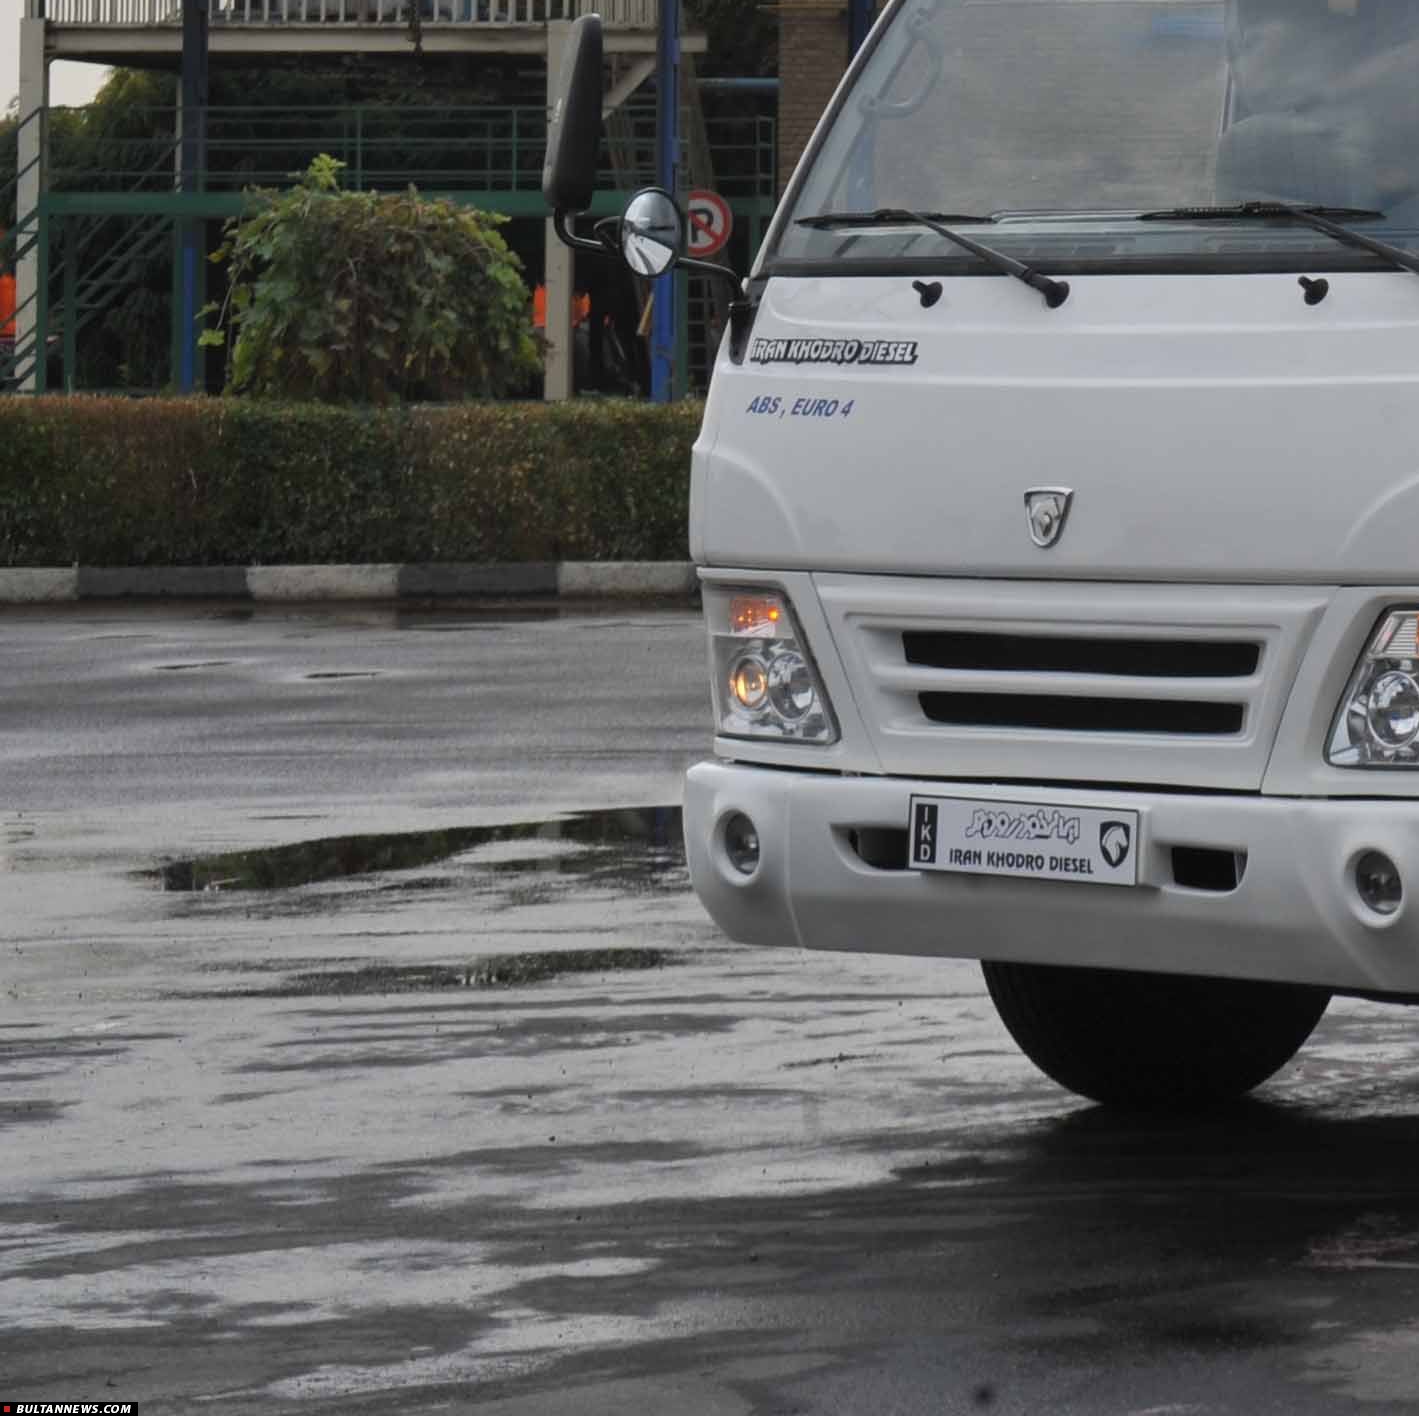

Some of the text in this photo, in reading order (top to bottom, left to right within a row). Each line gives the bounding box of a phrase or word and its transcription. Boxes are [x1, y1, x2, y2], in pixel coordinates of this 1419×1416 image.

[751, 339, 918, 365] IRAN KHODRO DIESEL
[791, 398, 839, 417] EURO
[841, 399, 854, 417] 4
[919, 806, 932, 861] IKD
[949, 848, 1094, 874] IRAN KHODRO DIESEL
